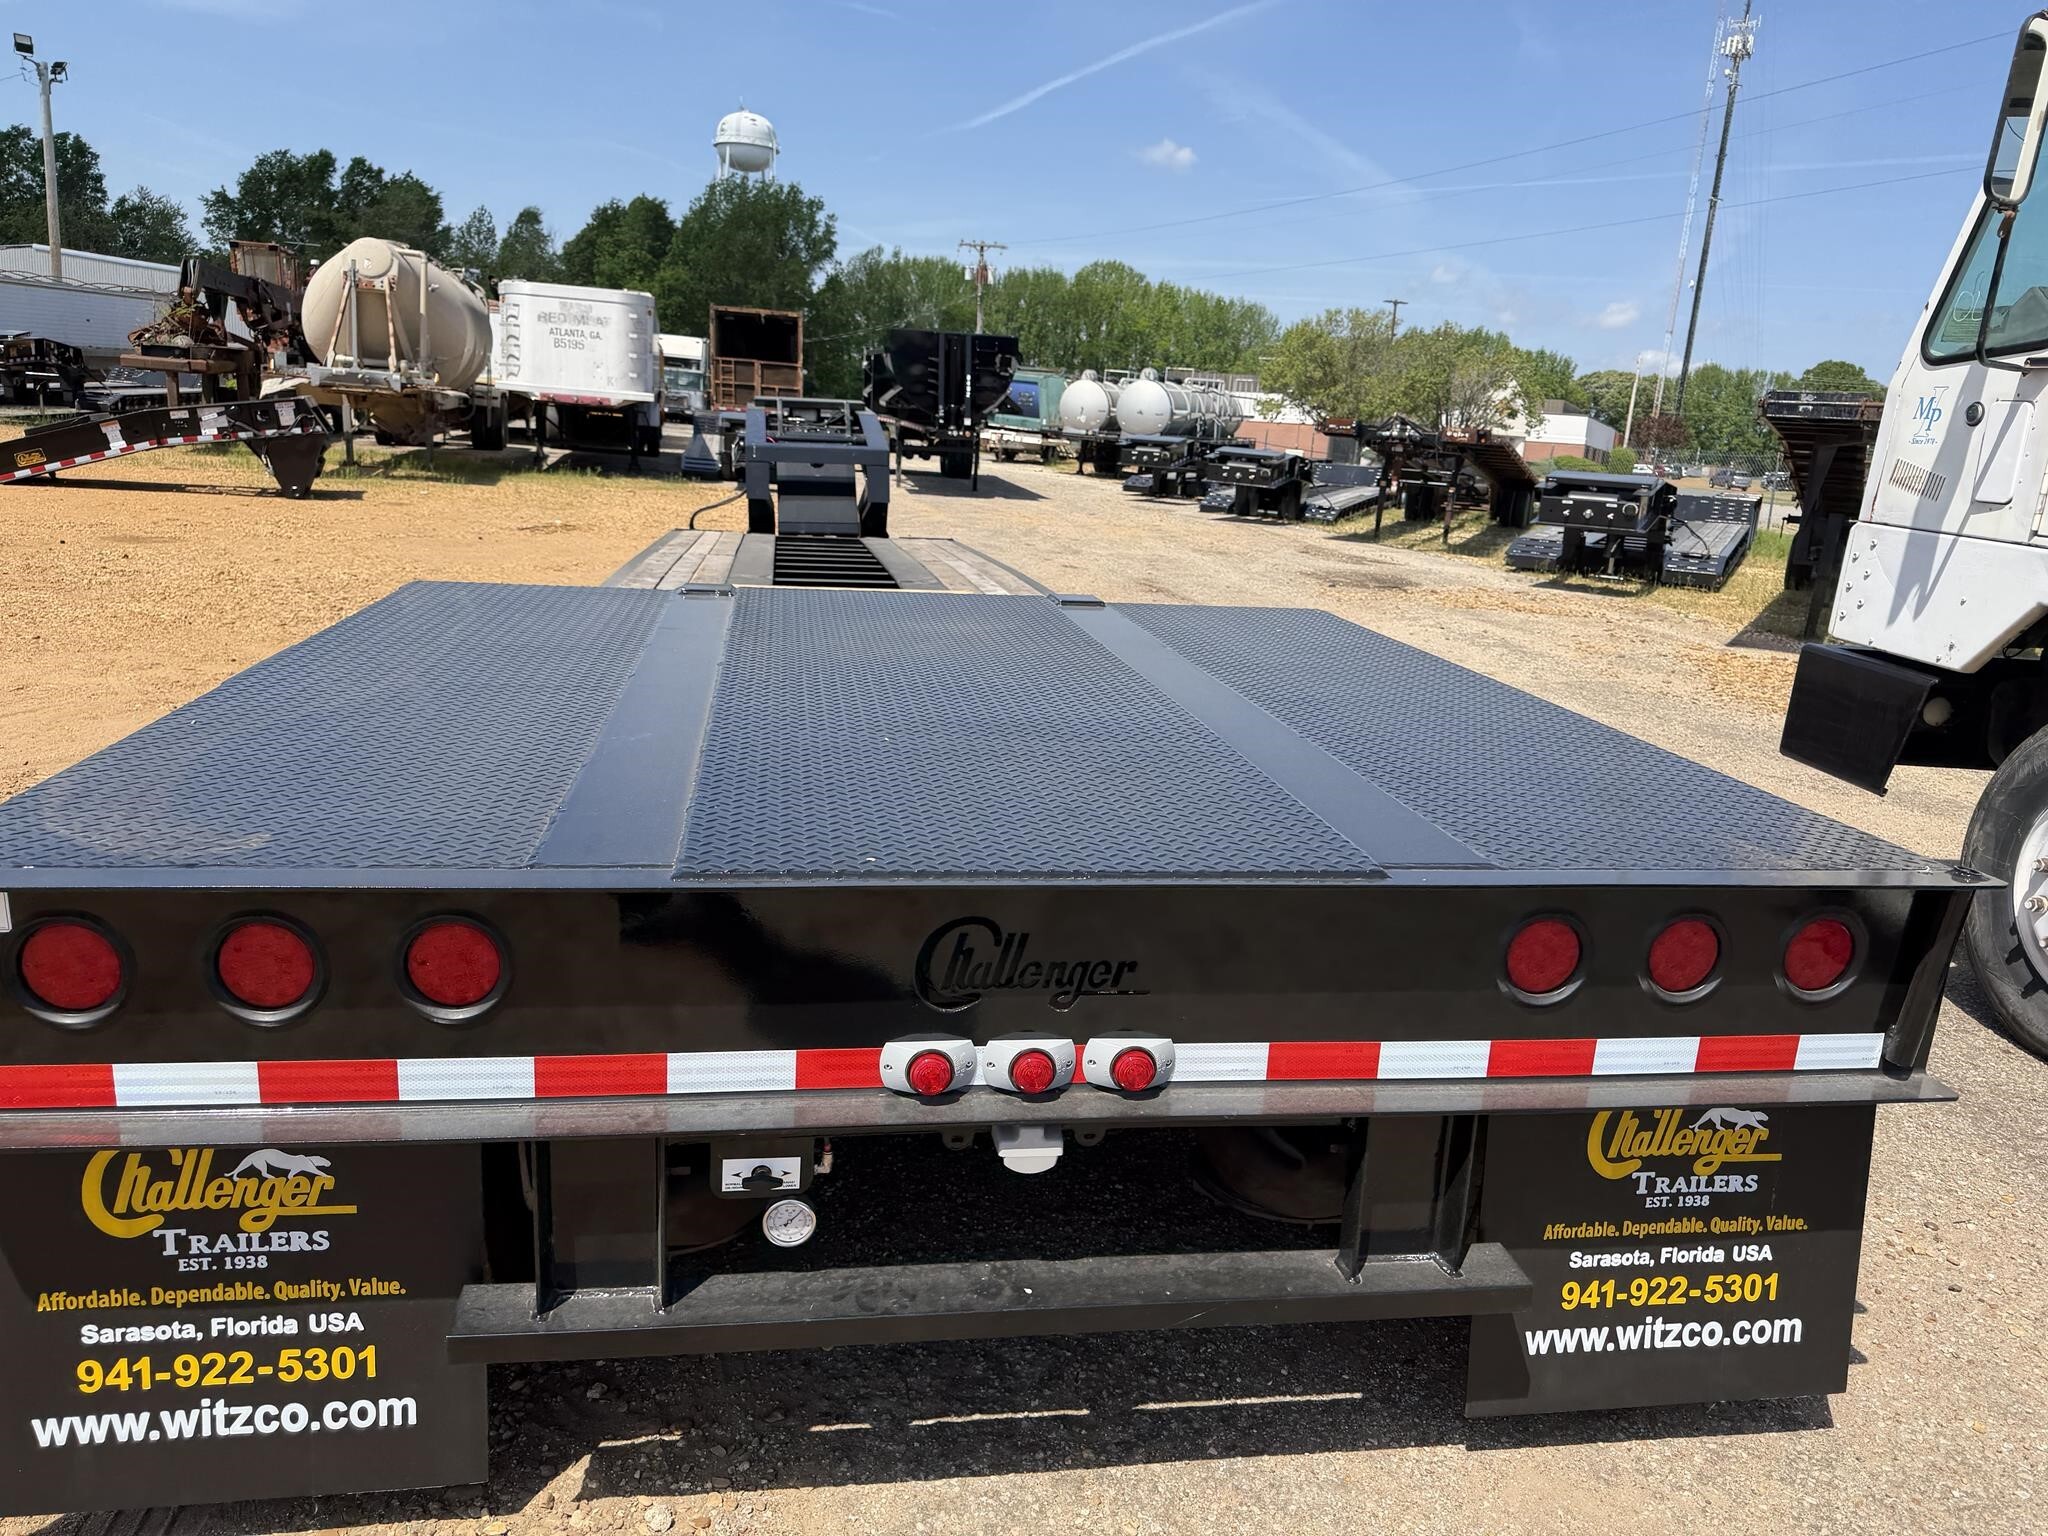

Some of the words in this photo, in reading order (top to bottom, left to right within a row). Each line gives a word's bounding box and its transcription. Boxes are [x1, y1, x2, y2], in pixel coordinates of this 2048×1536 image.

[549, 327, 587, 340] ATLANTA,
[553, 337, 585, 350] B5195
[913, 916, 1150, 1013] Challenger
[1587, 1109, 1782, 1180] Challenger
[82, 1148, 357, 1239] Challenger
[1631, 1171, 1759, 1195] TRAILERS
[1645, 1196, 1673, 1208] EST.
[1677, 1195, 1710, 1207] 1938
[152, 1228, 331, 1256] TRAILERS
[1543, 1220, 1620, 1241] Affordable.
[1622, 1216, 1708, 1239] Dependable.
[1710, 1215, 1763, 1235] Quality.
[1766, 1215, 1808, 1232] Value.
[178, 1257, 218, 1272] EST.
[224, 1255, 268, 1270] 1938
[1568, 1249, 1655, 1269] Sarasota,
[1660, 1246, 1725, 1265] Florida
[1732, 1245, 1773, 1262] USA
[37, 1288, 147, 1313] Affordable.
[151, 1281, 271, 1309] Dependable.
[273, 1279, 346, 1302] Quality.
[348, 1277, 407, 1297] Value.
[1560, 1272, 1780, 1311] 941-922-5301
[80, 1321, 203, 1345] Sarasota,
[210, 1314, 299, 1338] Florida
[308, 1311, 365, 1334] USA
[1525, 1316, 1803, 1356] www.witzco.com
[76, 1344, 377, 1395] 941-922-5301
[31, 1395, 418, 1449] www.witzco.com
